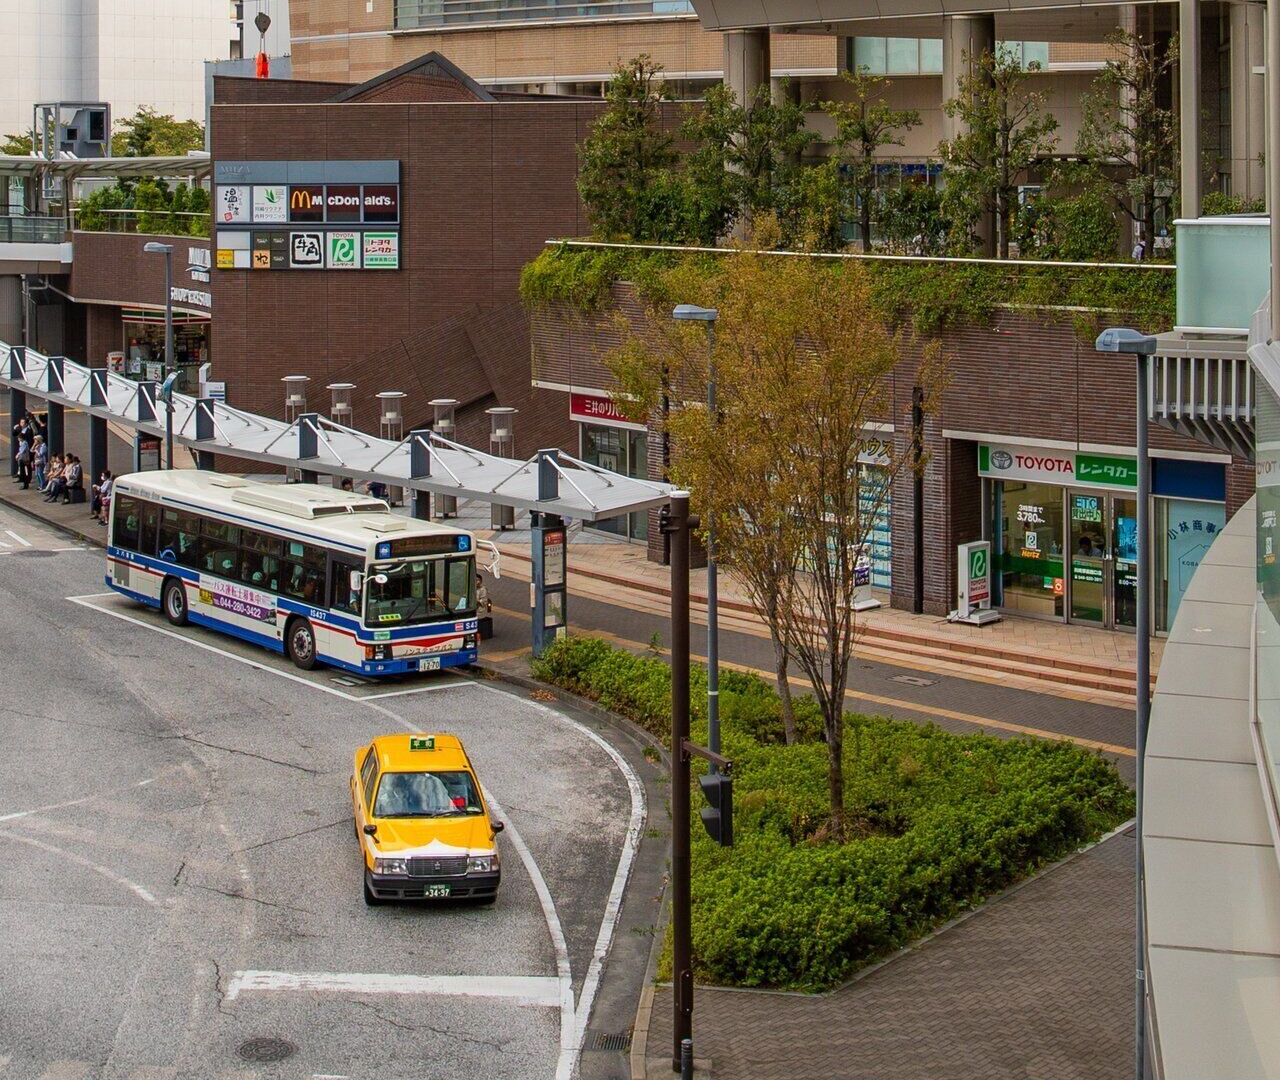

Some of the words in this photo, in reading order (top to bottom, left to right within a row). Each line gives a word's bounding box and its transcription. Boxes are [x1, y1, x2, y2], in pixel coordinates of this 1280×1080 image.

[296, 239, 319, 257] 牛角
[1015, 454, 1074, 474] TOYOTA
[1079, 463, 1138, 478] レンタカー
[219, 596, 262, 619] 044-280-3422
